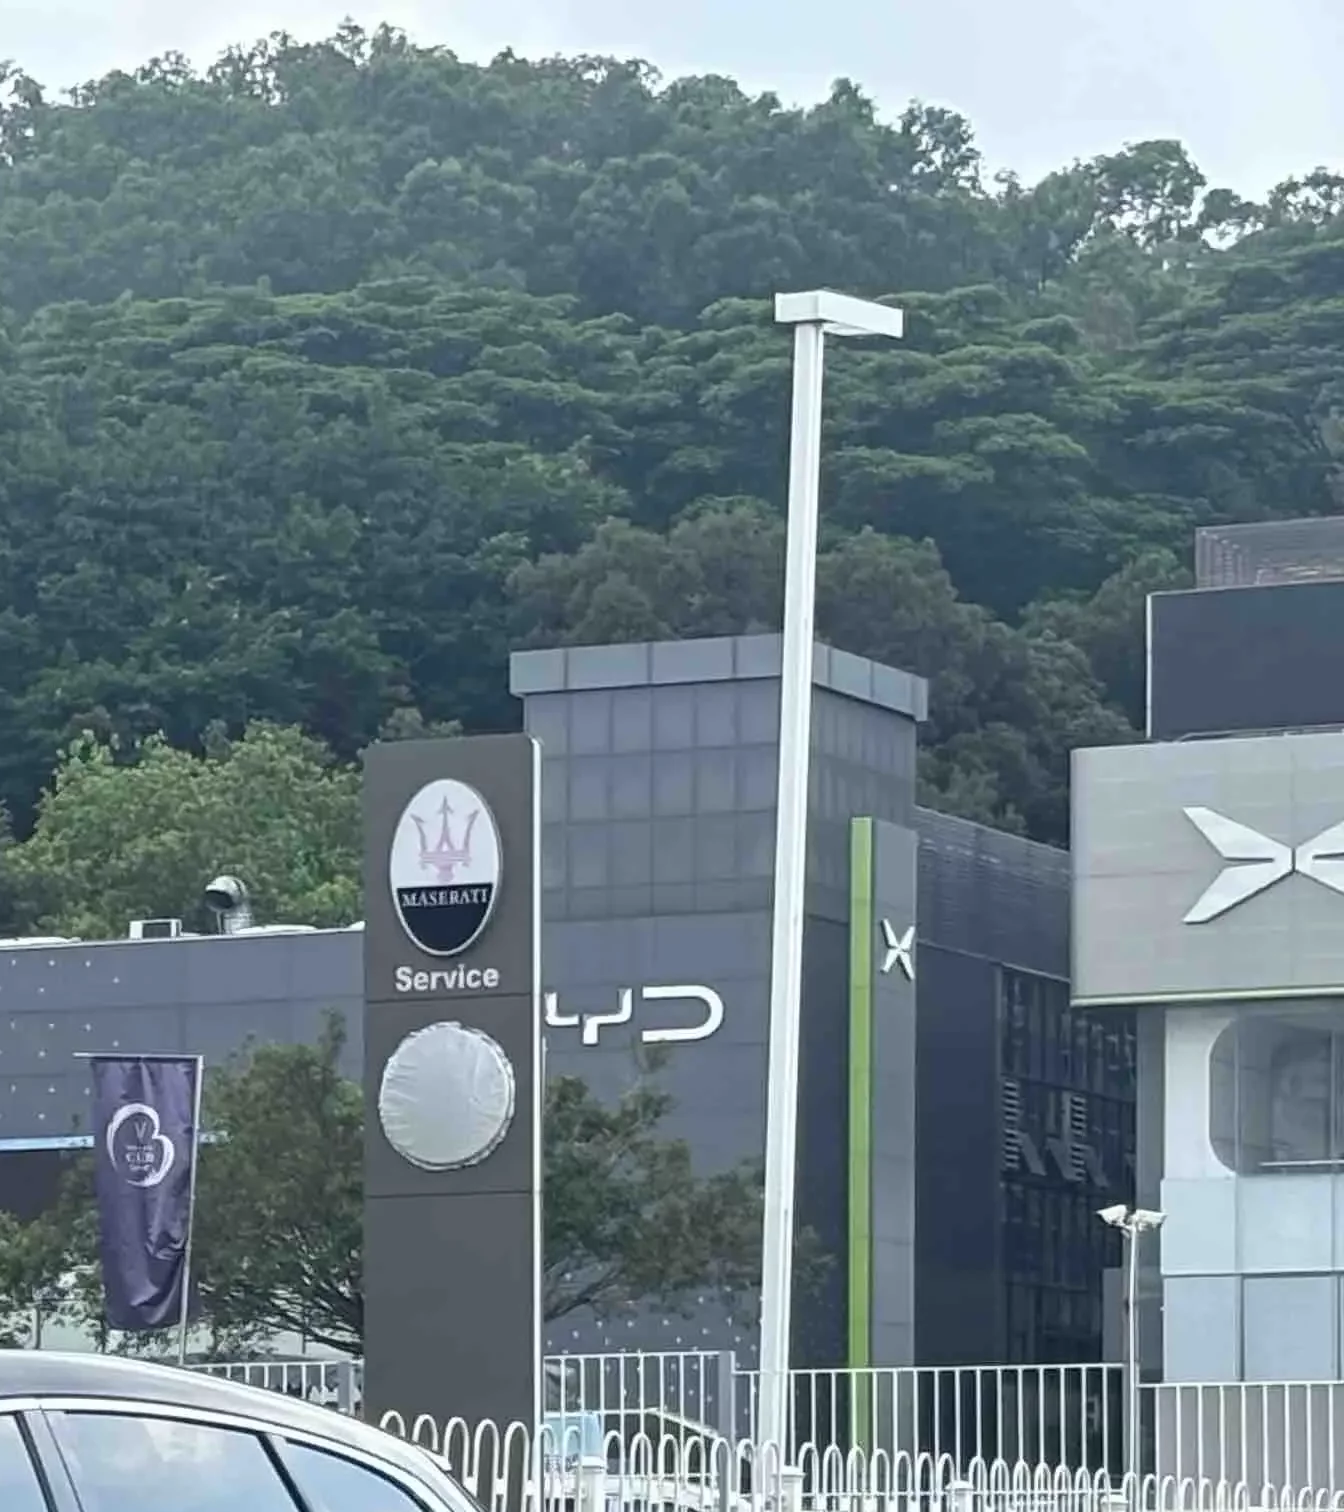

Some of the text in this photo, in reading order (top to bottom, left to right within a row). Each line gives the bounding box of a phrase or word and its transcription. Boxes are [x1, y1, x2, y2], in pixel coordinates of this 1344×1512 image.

[401, 888, 489, 908] MASERATI
[395, 963, 500, 992] Service
[543, 984, 724, 1045] YD
